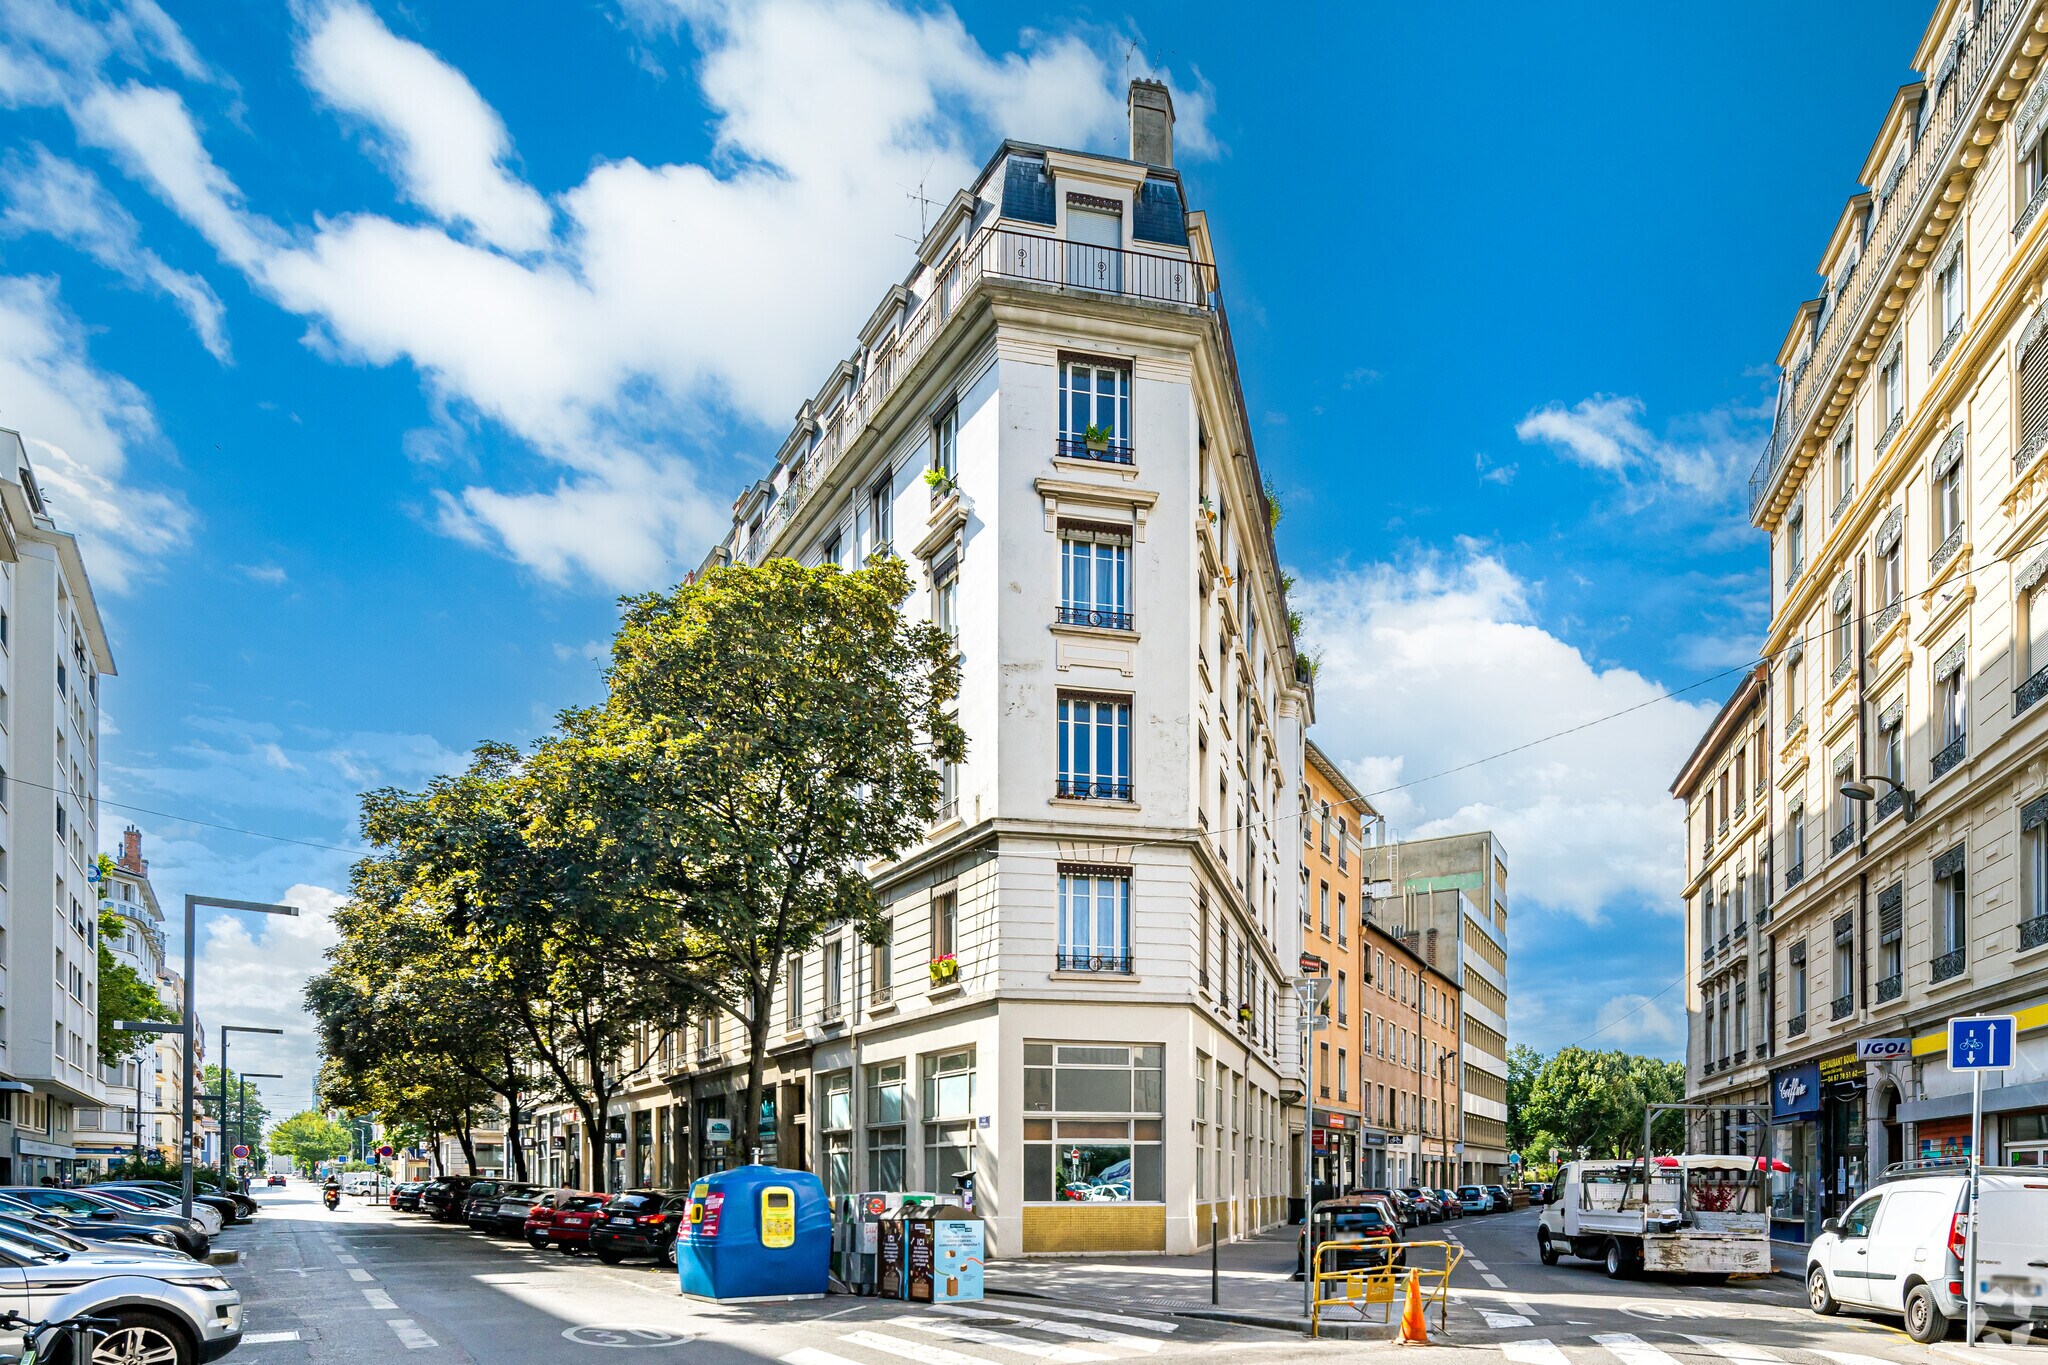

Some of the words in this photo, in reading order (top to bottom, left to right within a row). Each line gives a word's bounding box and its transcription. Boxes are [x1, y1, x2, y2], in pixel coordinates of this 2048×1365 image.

[1863, 1042, 1906, 1055] IGOL
[1820, 1056, 1843, 1071] RESTAURANT
[1779, 1078, 1807, 1105] Coiffure
[581, 1328, 672, 1344] 30
